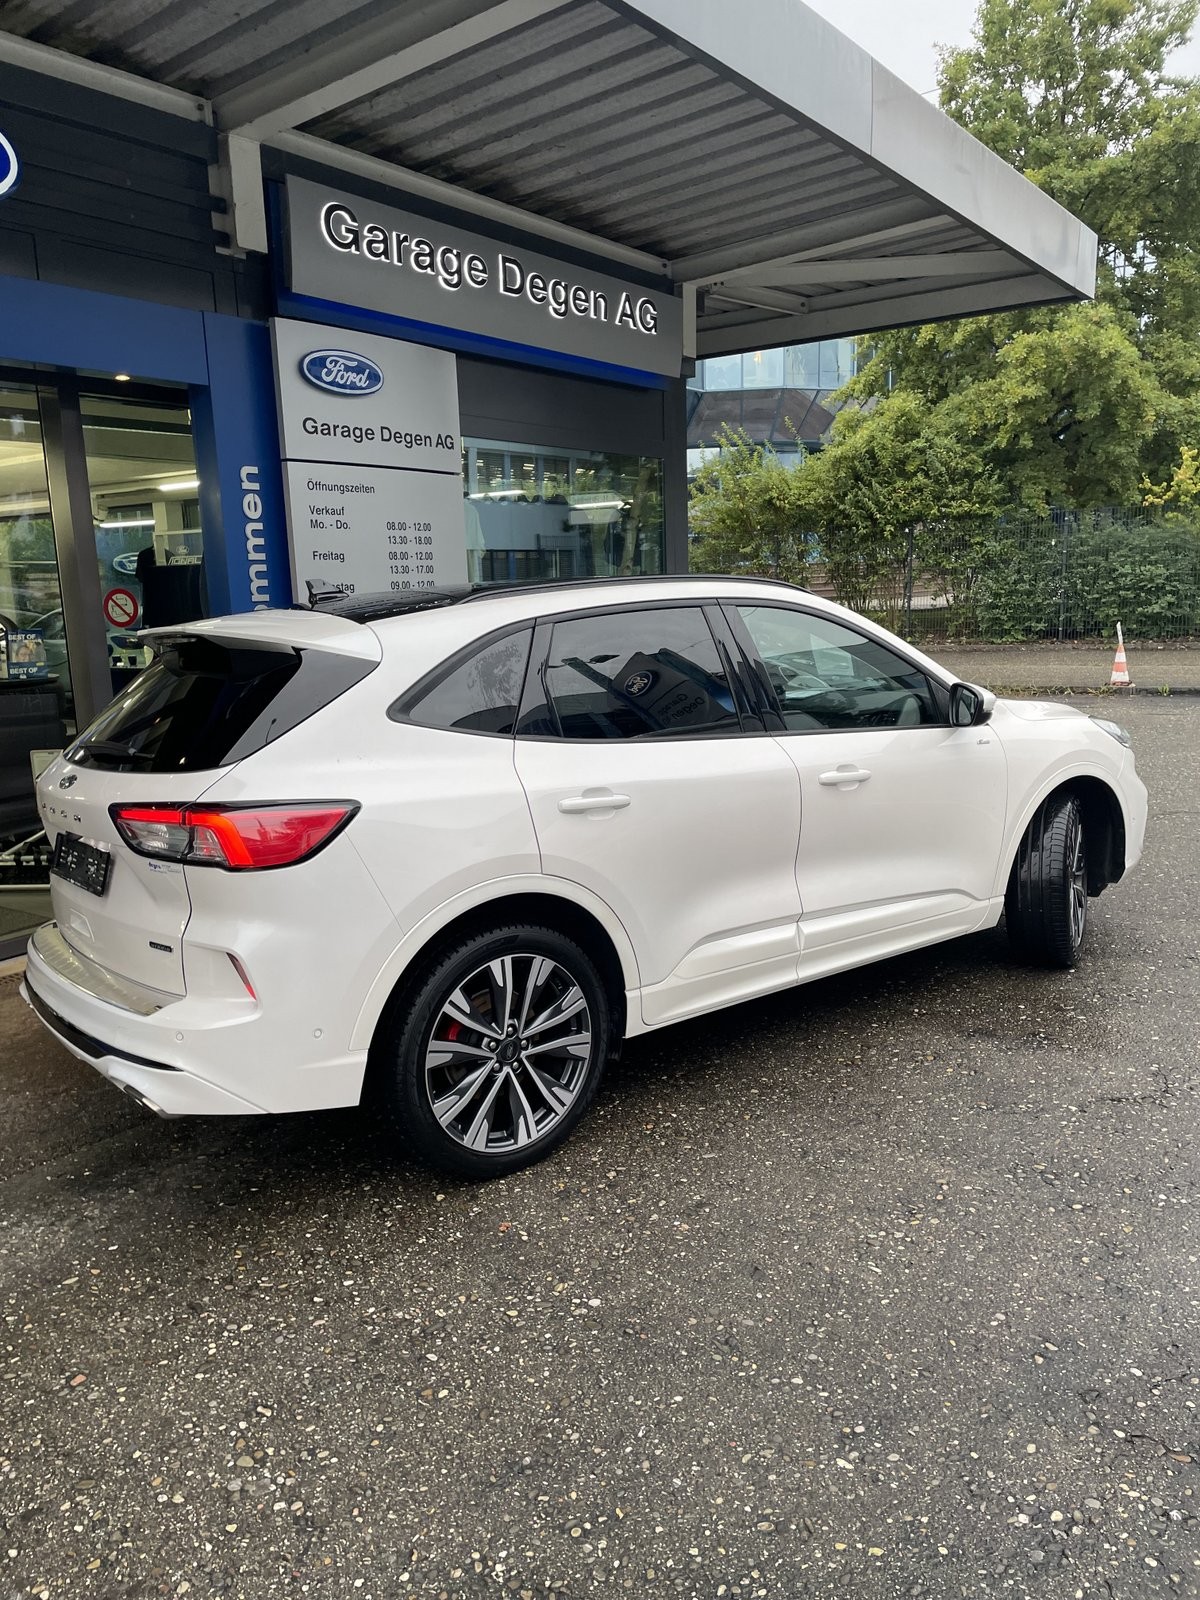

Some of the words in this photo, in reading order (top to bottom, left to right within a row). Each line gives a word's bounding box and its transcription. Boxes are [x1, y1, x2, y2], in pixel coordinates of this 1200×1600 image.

[320, 201, 488, 291] Garage
[498, 253, 608, 319] Degen
[615, 291, 658, 335] AG
[321, 356, 369, 388] Ford
[302, 416, 375, 443] Garage
[380, 426, 433, 449] Degen
[435, 433, 455, 450] AG
[307, 478, 375, 494] Öffnungszeiten
[308, 505, 345, 516] Verkauf
[310, 519, 328, 529] Mo.
[335, 519, 351, 530] Do.
[386, 521, 406, 531] 08.00
[413, 522, 432, 532] 12.00
[388, 535, 407, 545] 13.30
[414, 536, 432, 546] 18.00
[312, 550, 345, 562] Freitag
[388, 551, 409, 560] 08.00
[415, 551, 433, 561] 12.00
[390, 565, 409, 574] 13.30
[416, 565, 434, 574] 17.00
[390, 581, 410, 590] 09.00
[9, 667, 27, 675] BEST
